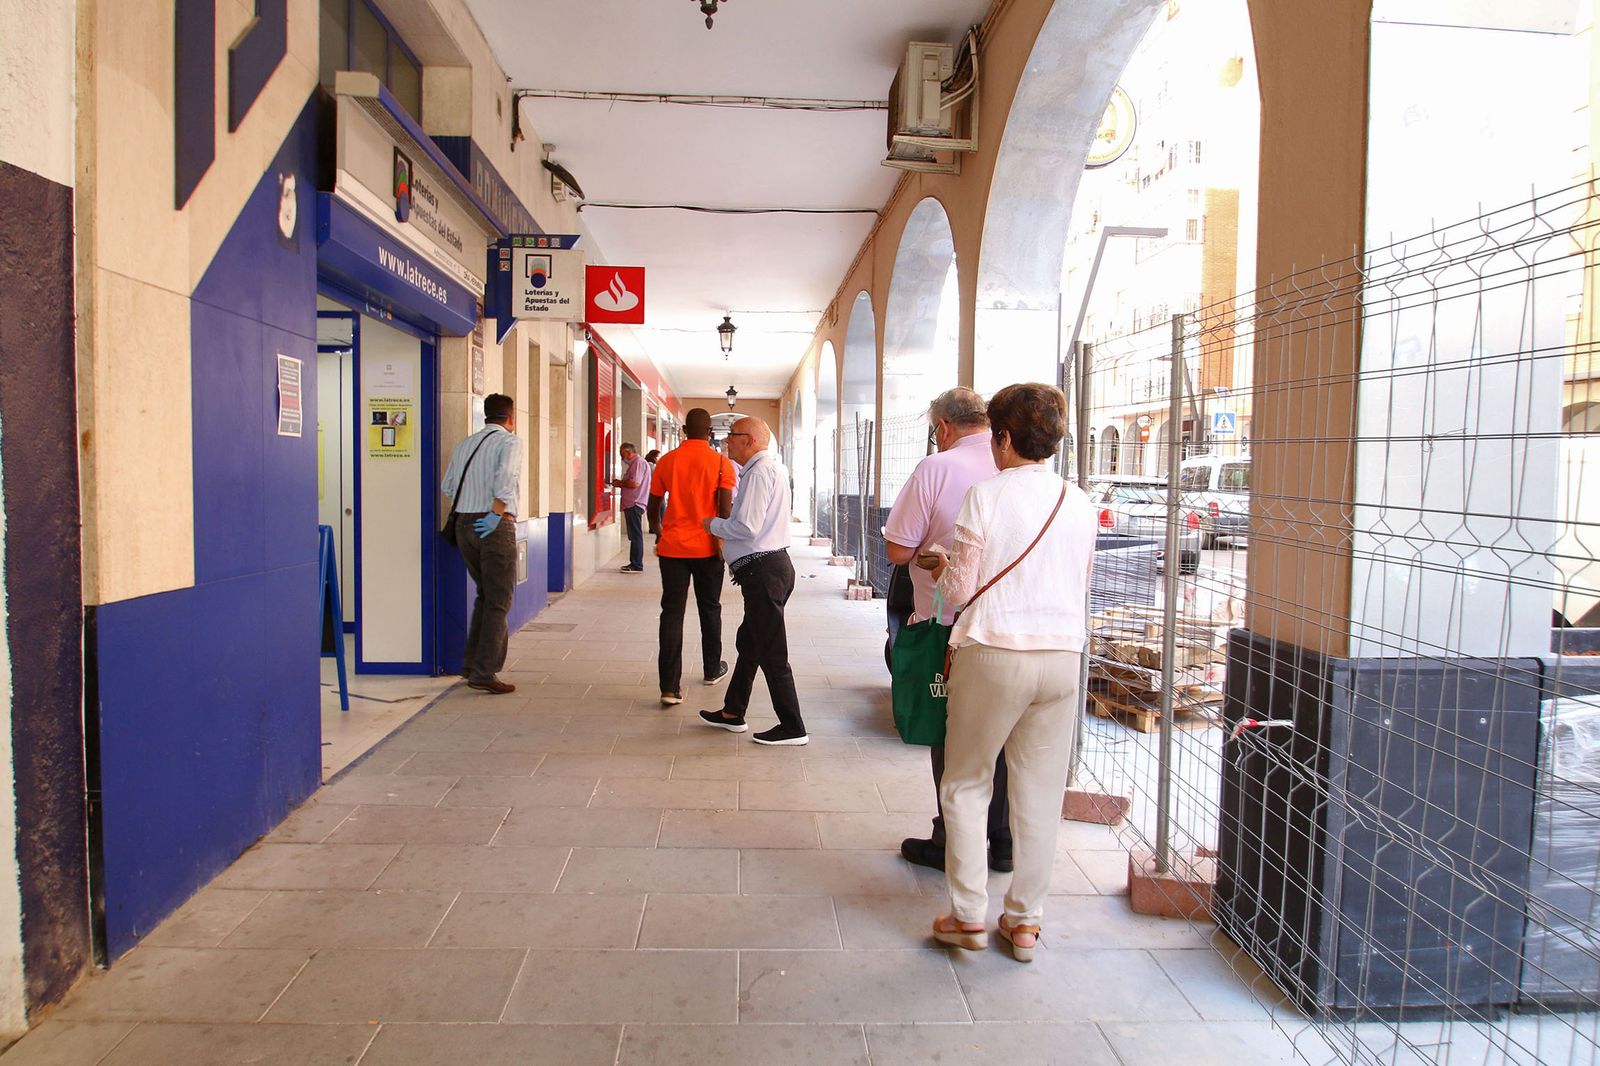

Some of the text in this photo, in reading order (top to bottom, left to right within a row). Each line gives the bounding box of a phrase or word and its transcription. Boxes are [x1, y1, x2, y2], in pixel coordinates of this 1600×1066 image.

[435, 198, 438, 214] y
[438, 220, 446, 239] del
[446, 228, 463, 253] Estado
[378, 246, 448, 304] www.latrece.es
